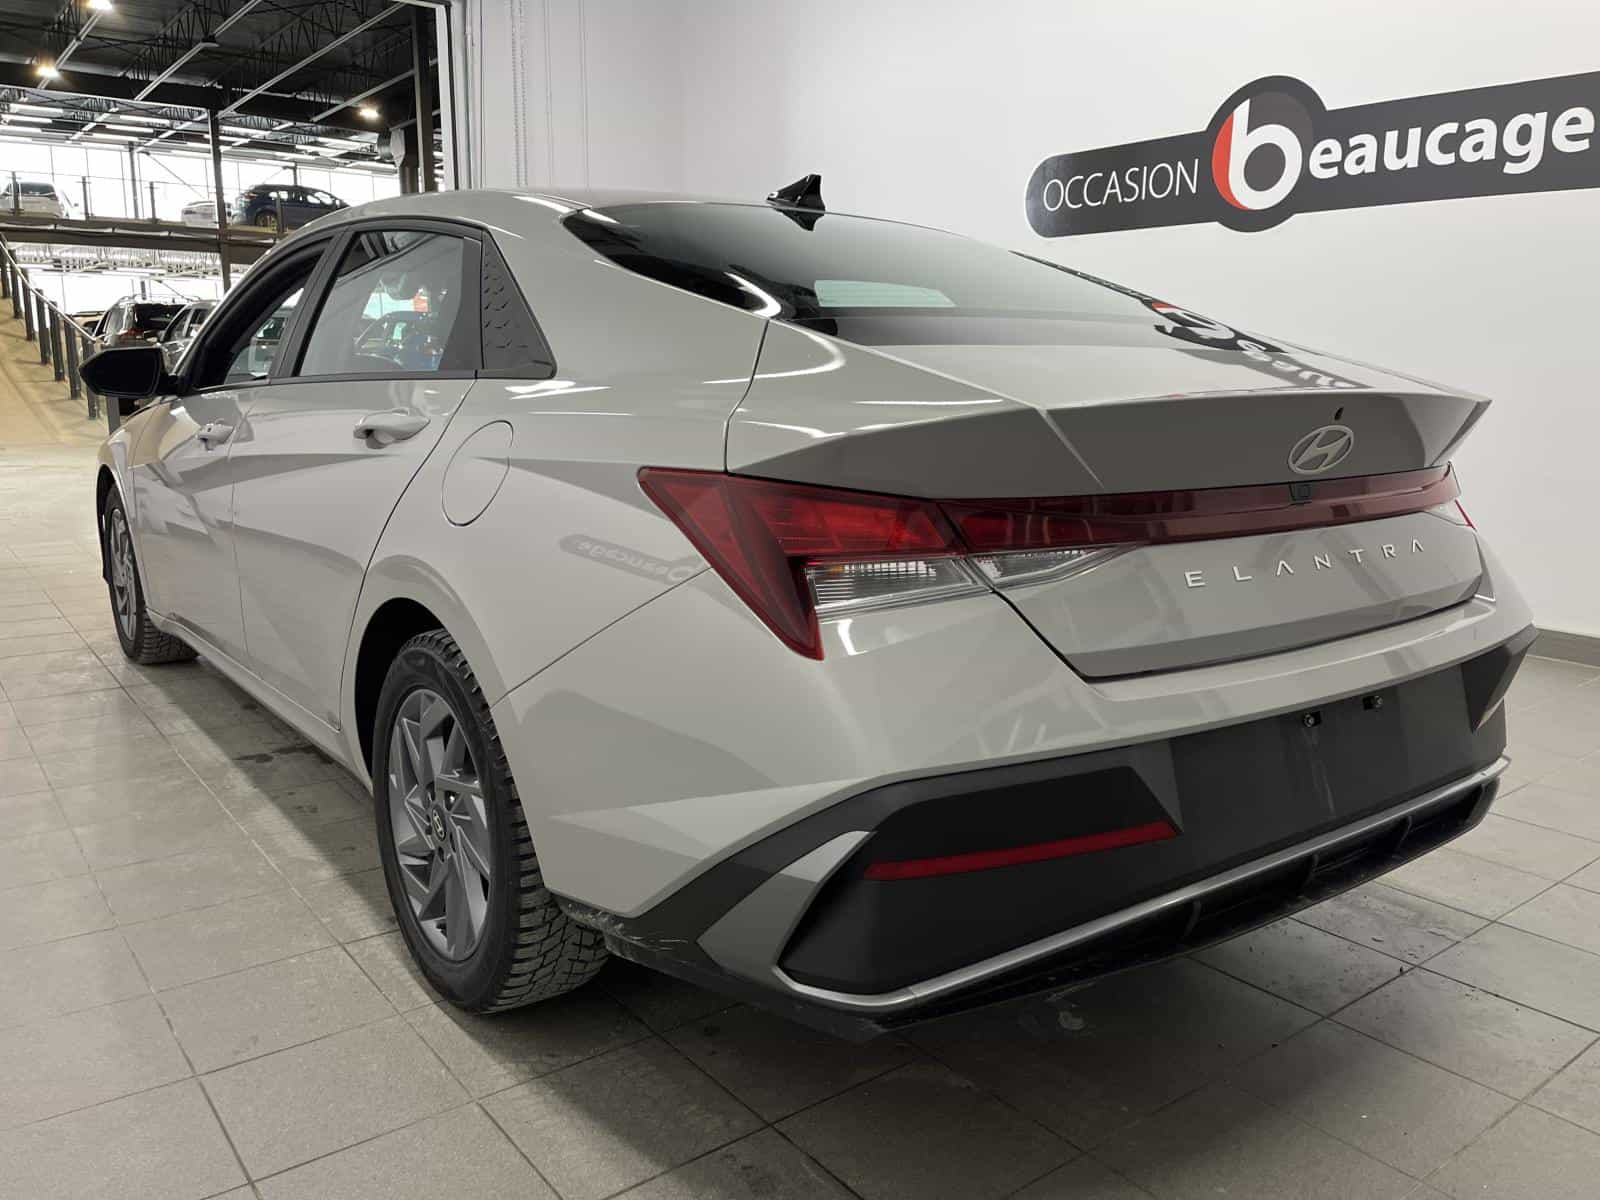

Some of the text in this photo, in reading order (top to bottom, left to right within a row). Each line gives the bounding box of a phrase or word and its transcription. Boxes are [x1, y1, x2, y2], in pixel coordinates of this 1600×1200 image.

[1043, 97, 1596, 212] OCCASION beaucage
[1184, 538, 1425, 589] ELANTRA
